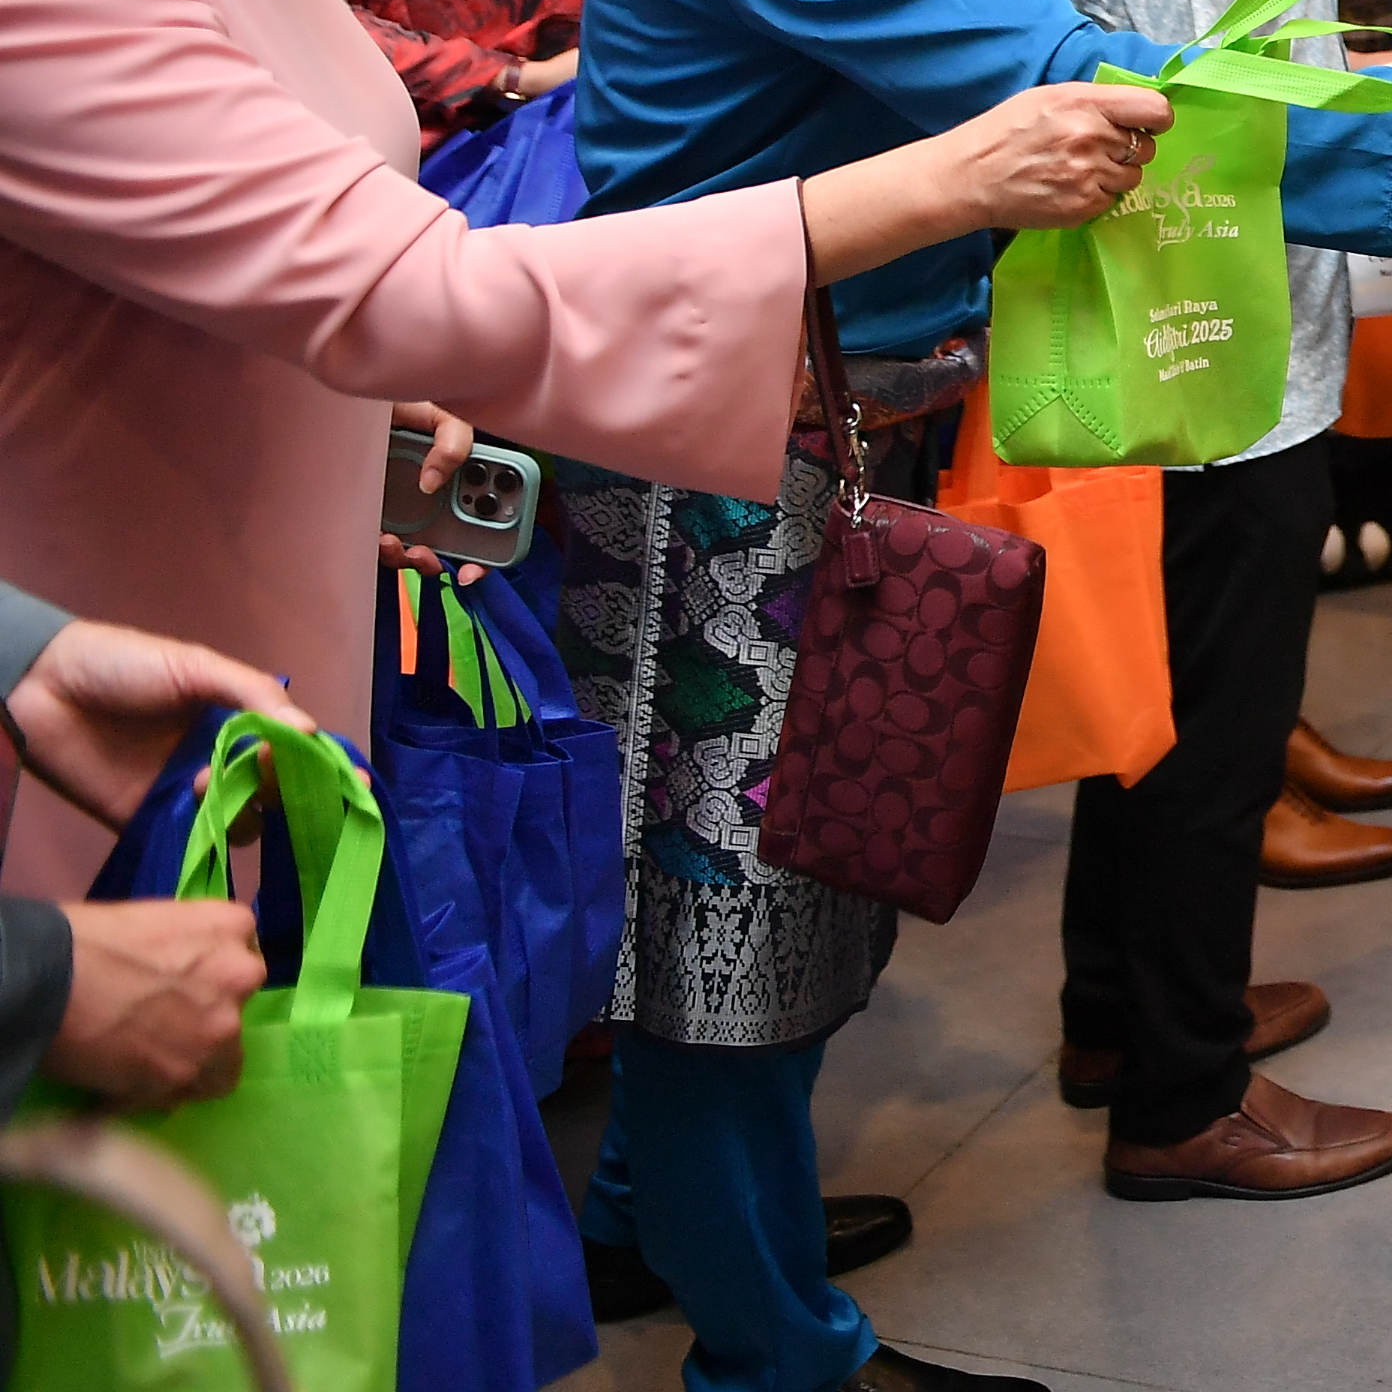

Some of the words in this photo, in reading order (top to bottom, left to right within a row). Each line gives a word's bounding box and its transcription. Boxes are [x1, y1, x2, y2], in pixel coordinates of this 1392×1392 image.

[1204, 193, 1237, 208] 2026
[1152, 212, 1194, 251] Truly
[1198, 219, 1240, 238] Asia
[1183, 299, 1219, 315] Raya
[1191, 318, 1234, 345] 2025
[1185, 357, 1210, 372] Batin
[37, 1250, 266, 1304] Malays
[270, 1264, 330, 1291] 2026
[153, 1298, 232, 1361] Tru
